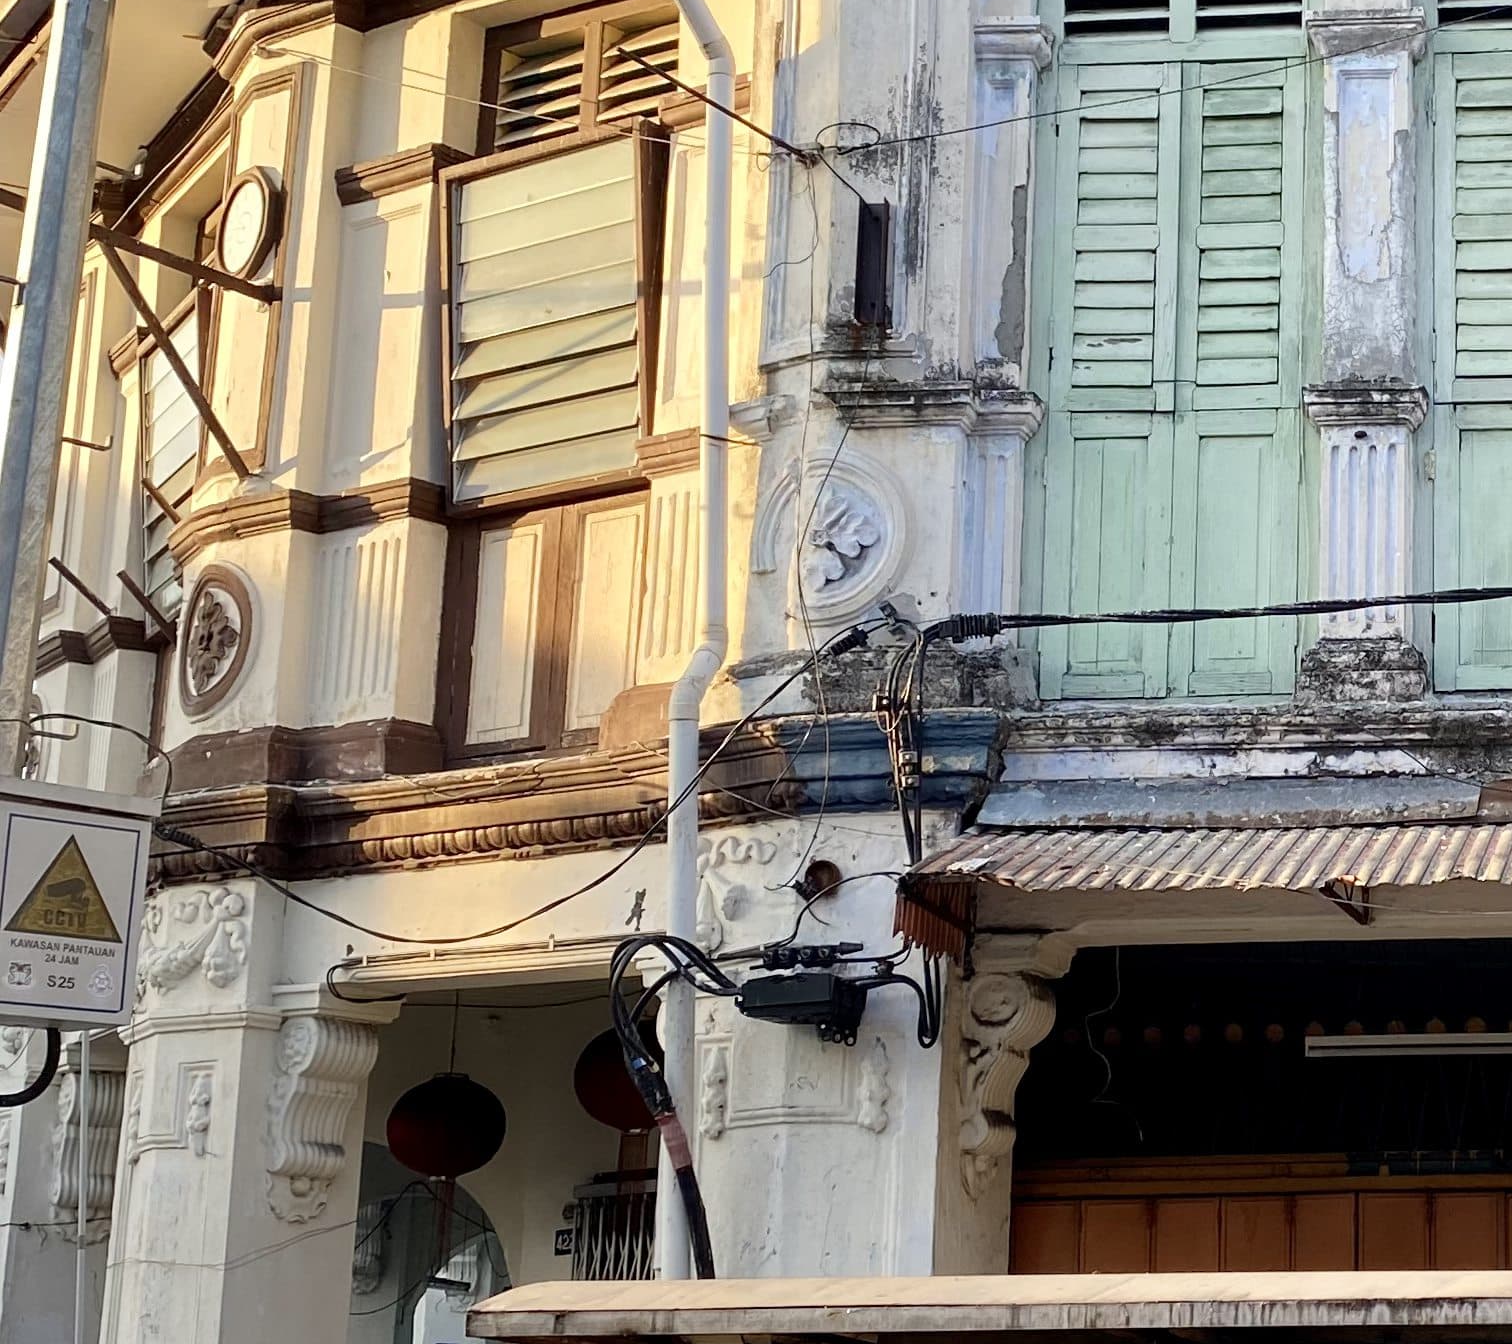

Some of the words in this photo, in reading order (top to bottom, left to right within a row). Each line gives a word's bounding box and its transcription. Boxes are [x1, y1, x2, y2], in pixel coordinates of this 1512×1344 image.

[10, 937, 60, 952] KAWASAN
[62, 942, 116, 958] PANTAUAN
[44, 953, 56, 963] 24
[58, 956, 79, 965] JAM
[47, 975, 75, 989] S25
